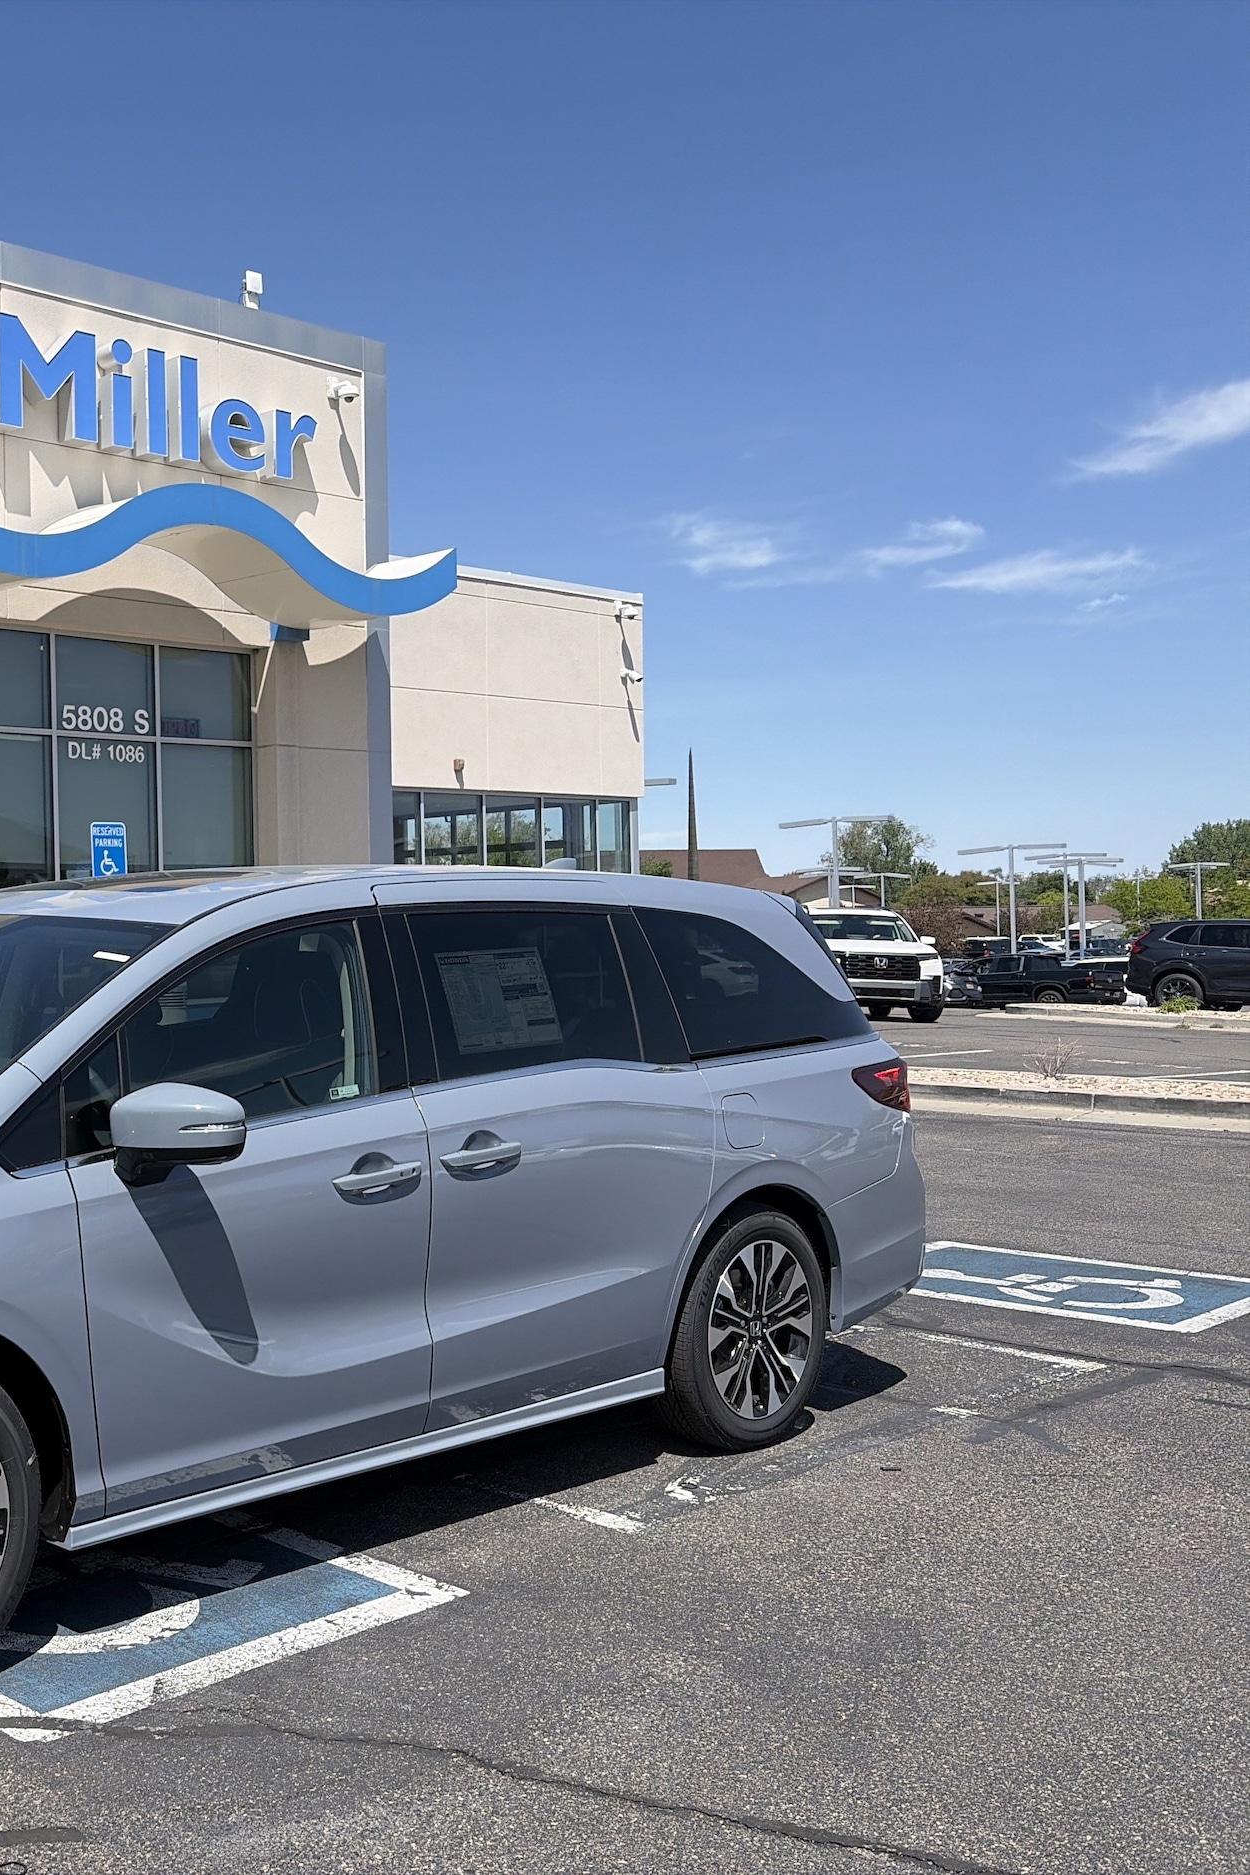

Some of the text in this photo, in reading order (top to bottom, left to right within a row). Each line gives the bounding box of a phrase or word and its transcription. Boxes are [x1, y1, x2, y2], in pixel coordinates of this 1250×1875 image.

[61, 704, 150, 734] 5808 S
[68, 741, 145, 763] DL# 1086
[92, 826, 124, 837] RESERVED
[94, 838, 123, 848] PARKING
[444, 956, 469, 964] HONDA
